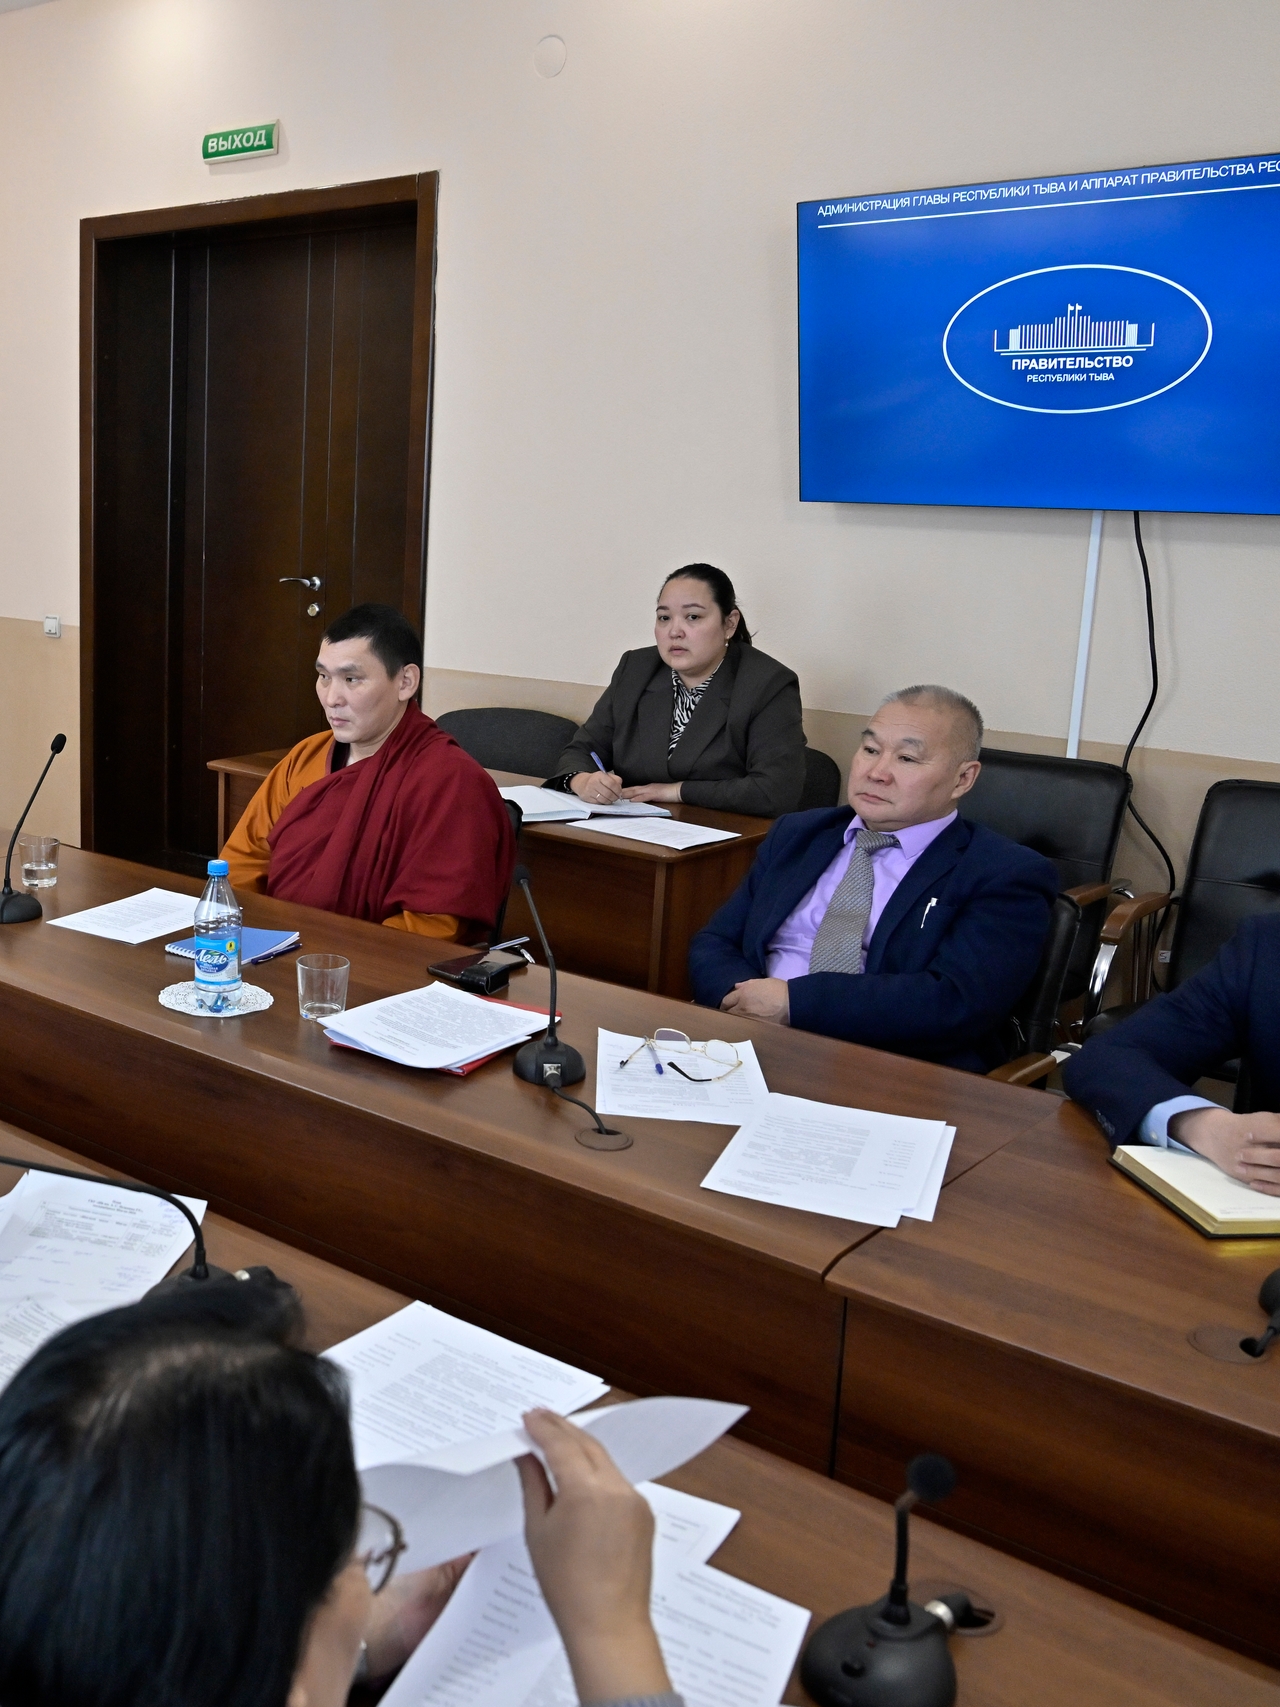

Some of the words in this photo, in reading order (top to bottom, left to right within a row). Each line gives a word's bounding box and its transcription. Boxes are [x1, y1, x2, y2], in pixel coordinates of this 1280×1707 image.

[208, 130, 266, 153] ВЫХОД
[817, 197, 910, 217] АДМИНИСТРАЦИЯ
[912, 193, 950, 207] ГЛАВЫ
[952, 184, 1030, 203] РЕСПУБЛИКИ
[1032, 182, 1066, 195] ТЫВА
[1069, 180, 1078, 191] И
[1080, 174, 1139, 190] АППАРАТ
[1140, 163, 1255, 184] ПРАВИТЕЛЬСТВА
[1012, 355, 1134, 370] ПРАВИТЕЛЬСТВО
[1026, 373, 1087, 383] РЕСПУБЛИКИ
[1088, 372, 1115, 381] ТЫВА
[195, 949, 227, 965] Лель
